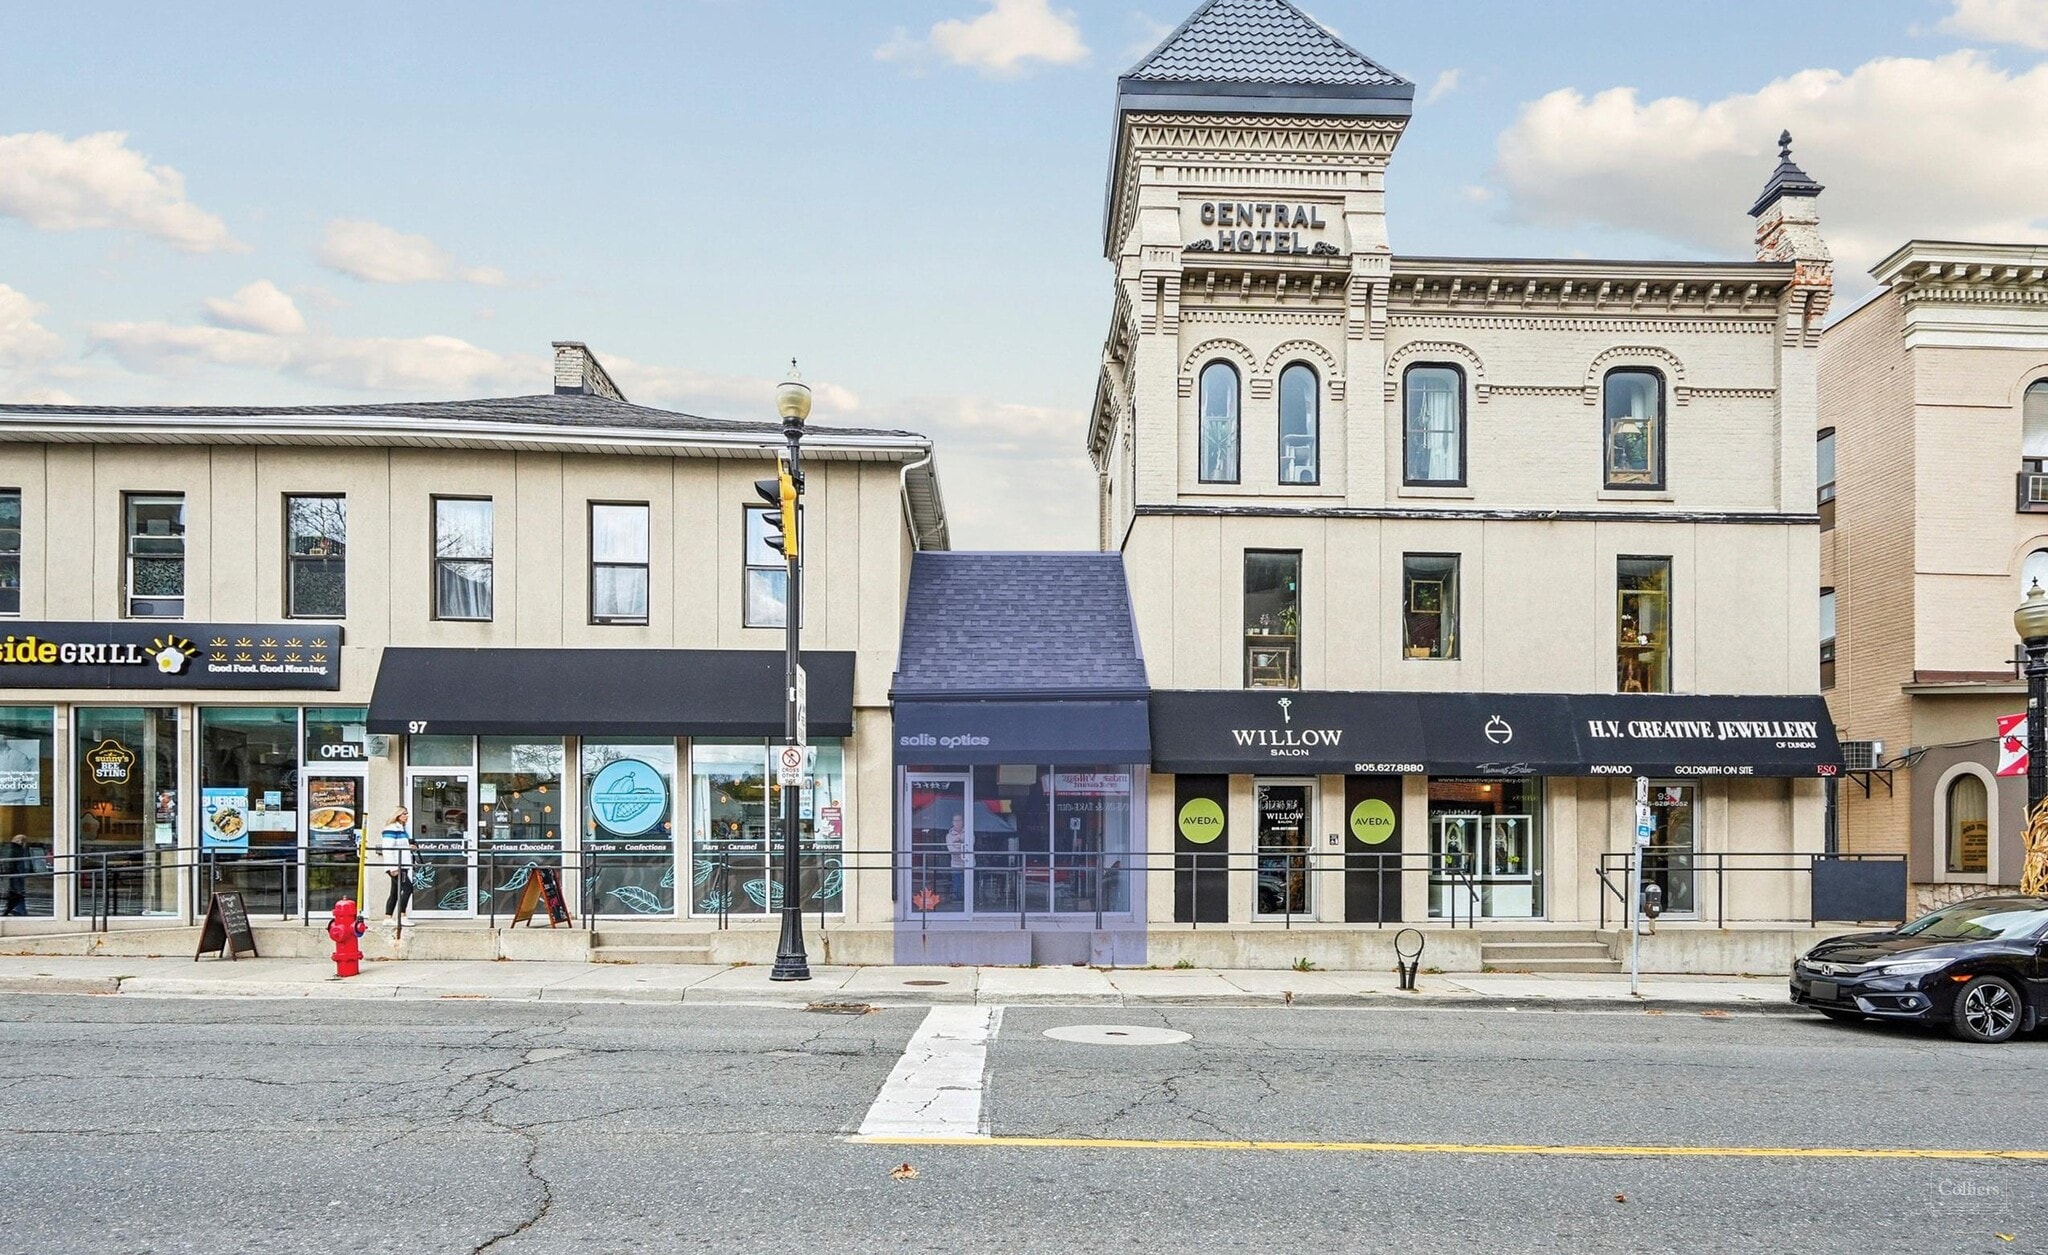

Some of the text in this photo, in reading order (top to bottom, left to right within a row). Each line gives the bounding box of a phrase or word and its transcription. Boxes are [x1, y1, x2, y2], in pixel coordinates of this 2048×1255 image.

[1200, 202, 1326, 229] CENTRAL
[1217, 230, 1309, 253] HOTEL
[0, 636, 142, 664] ide GRILL
[208, 664, 328, 675] Good Food. Good Morning.
[408, 721, 428, 734] 97
[1588, 720, 1818, 740] H.V. CREATIVE JEWELLERY
[900, 733, 990, 749] solis optics
[1231, 729, 1343, 746] WILLOW
[320, 744, 359, 758] OPEN
[95, 755, 129, 763] sunny's
[101, 762, 120, 770] BEE
[1354, 763, 1424, 772] 905.627.8880
[1590, 765, 1632, 774] MOVADO
[1674, 766, 1754, 775] GOLDSMITH ON SITE
[1817, 765, 1837, 775] ESQ
[96, 769, 127, 777] STING
[18, 781, 37, 790] food
[435, 781, 447, 789] 97
[1657, 793, 1670, 801] 93
[1183, 816, 1219, 825] AVEDA
[1266, 812, 1304, 820] WILLOW
[1354, 817, 1390, 826] AVEDA
